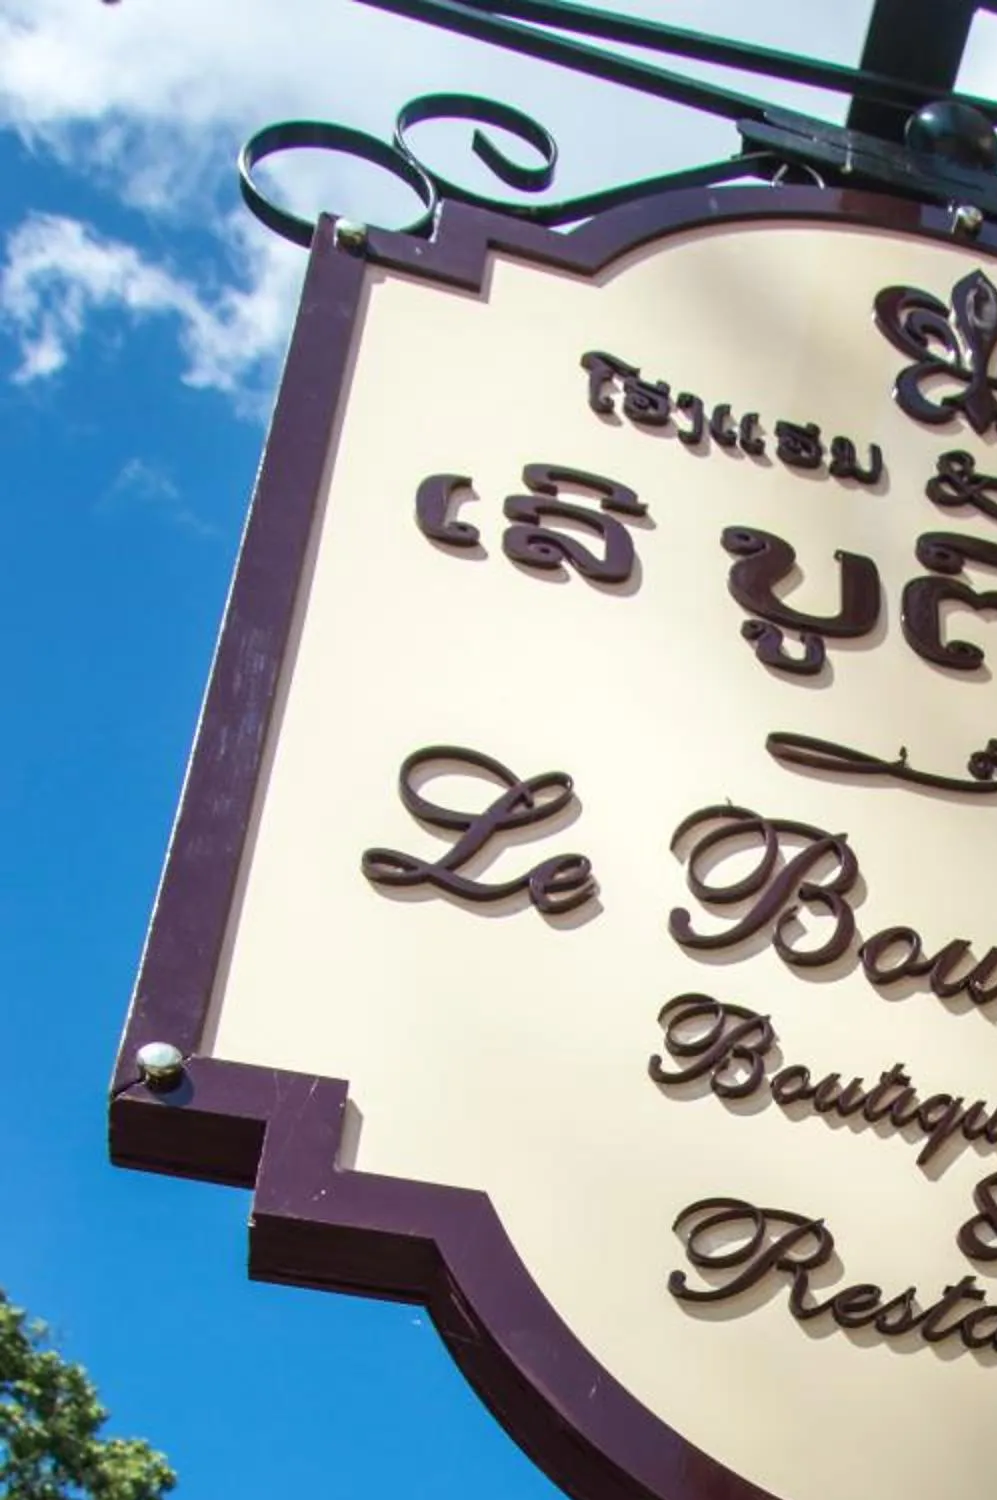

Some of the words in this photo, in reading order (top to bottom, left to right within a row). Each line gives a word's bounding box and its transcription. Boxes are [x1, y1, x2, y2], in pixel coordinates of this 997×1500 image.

[581, 352, 884, 487] ໂຮງແຮມ
[361, 746, 596, 917] Le
